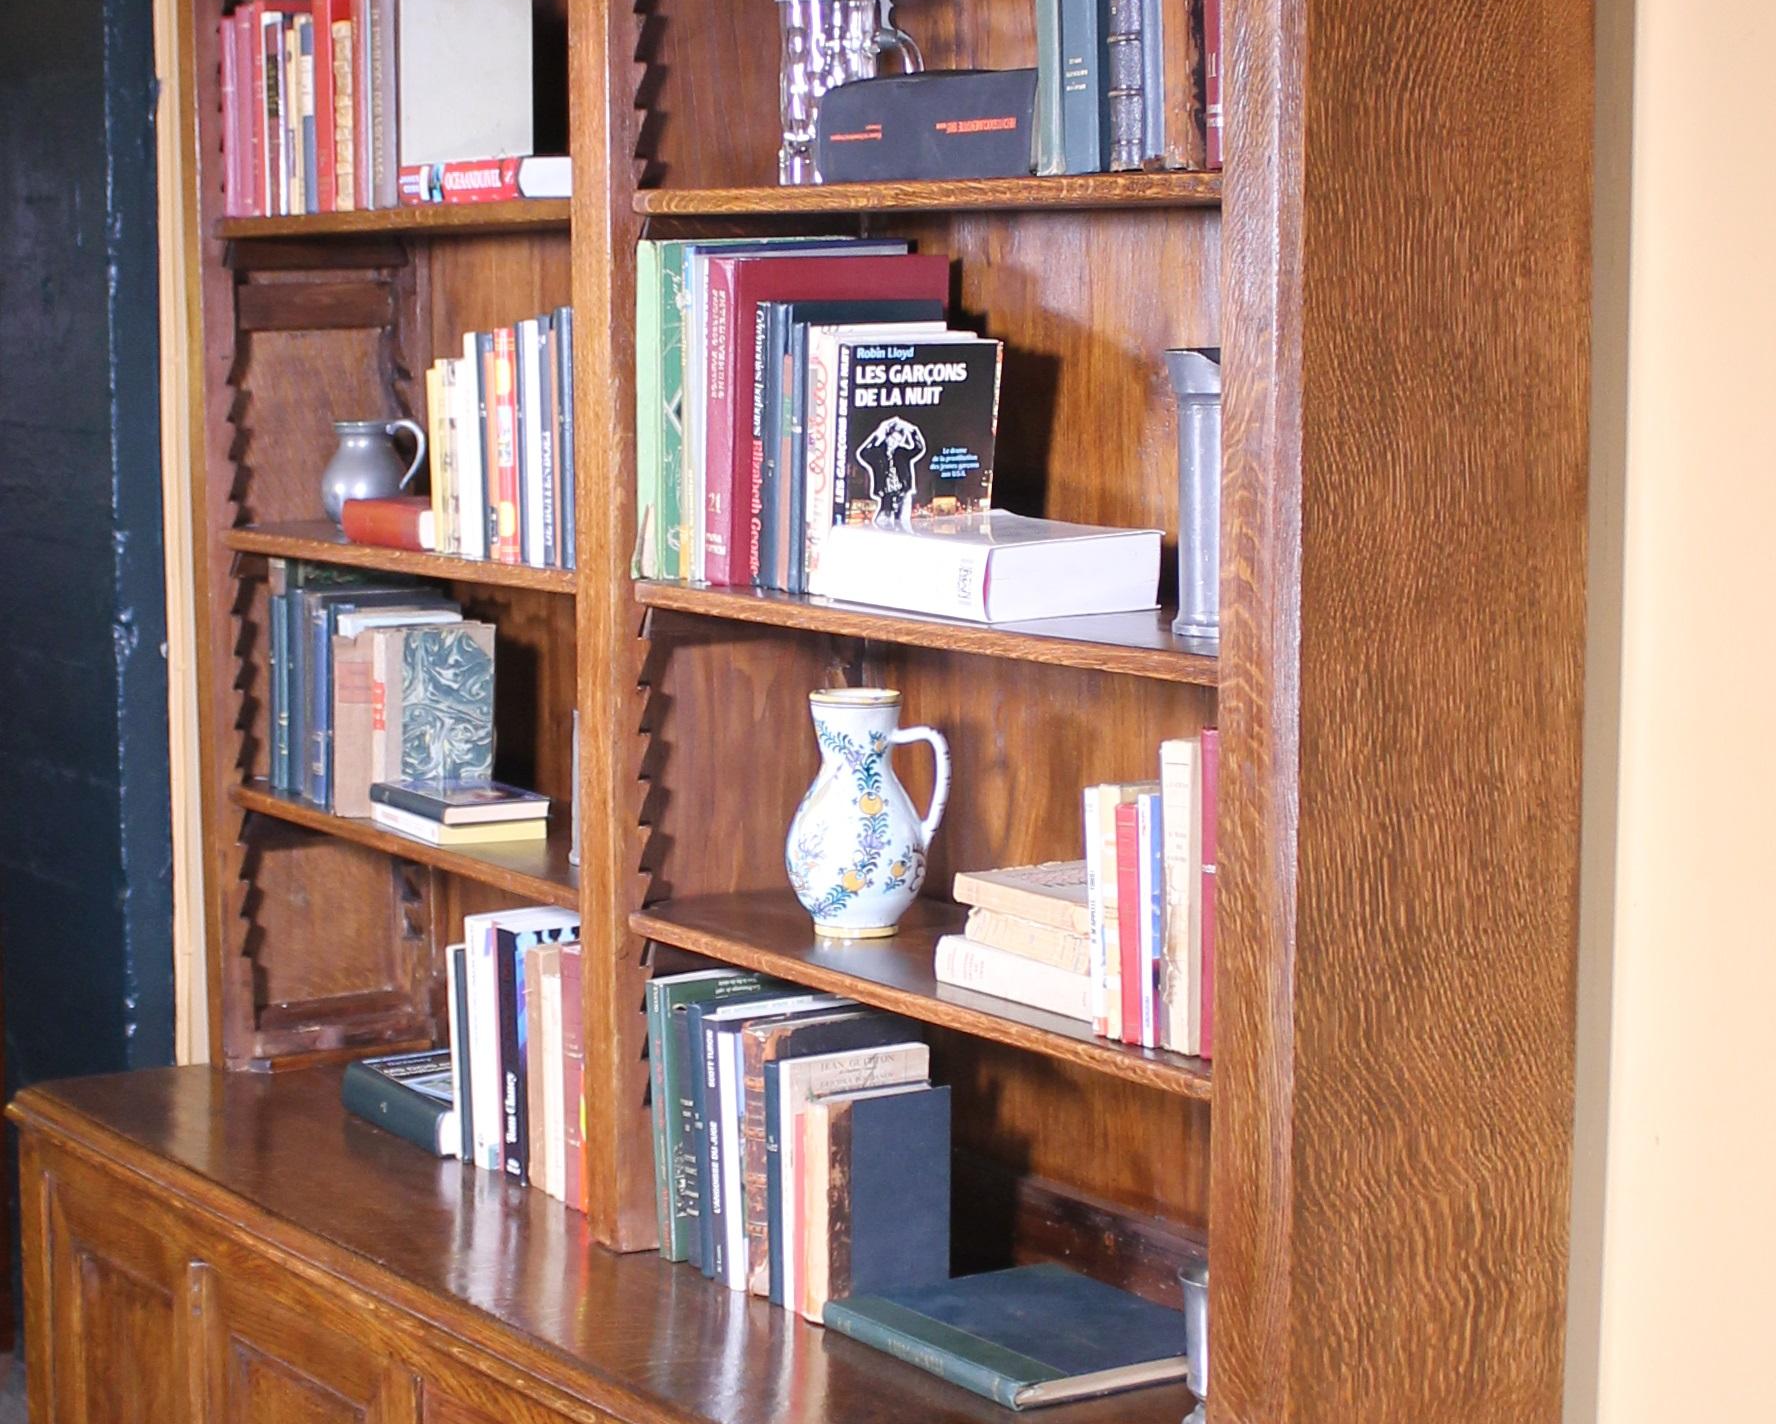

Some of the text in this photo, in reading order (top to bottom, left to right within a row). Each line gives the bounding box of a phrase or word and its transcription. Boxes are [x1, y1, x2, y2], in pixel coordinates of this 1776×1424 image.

[855, 362, 967, 386] LES GARÇONS
[856, 346, 914, 361] Robin Lloyd
[854, 386, 943, 407] DE LA NUIT
[835, 346, 850, 504] LES GARÇONS DE LA NUIT
[750, 439, 764, 515] Elizabeth
[749, 517, 762, 576] George
[706, 1029, 716, 1088] SCOTT TUROW
[710, 1145, 719, 1161] DU
